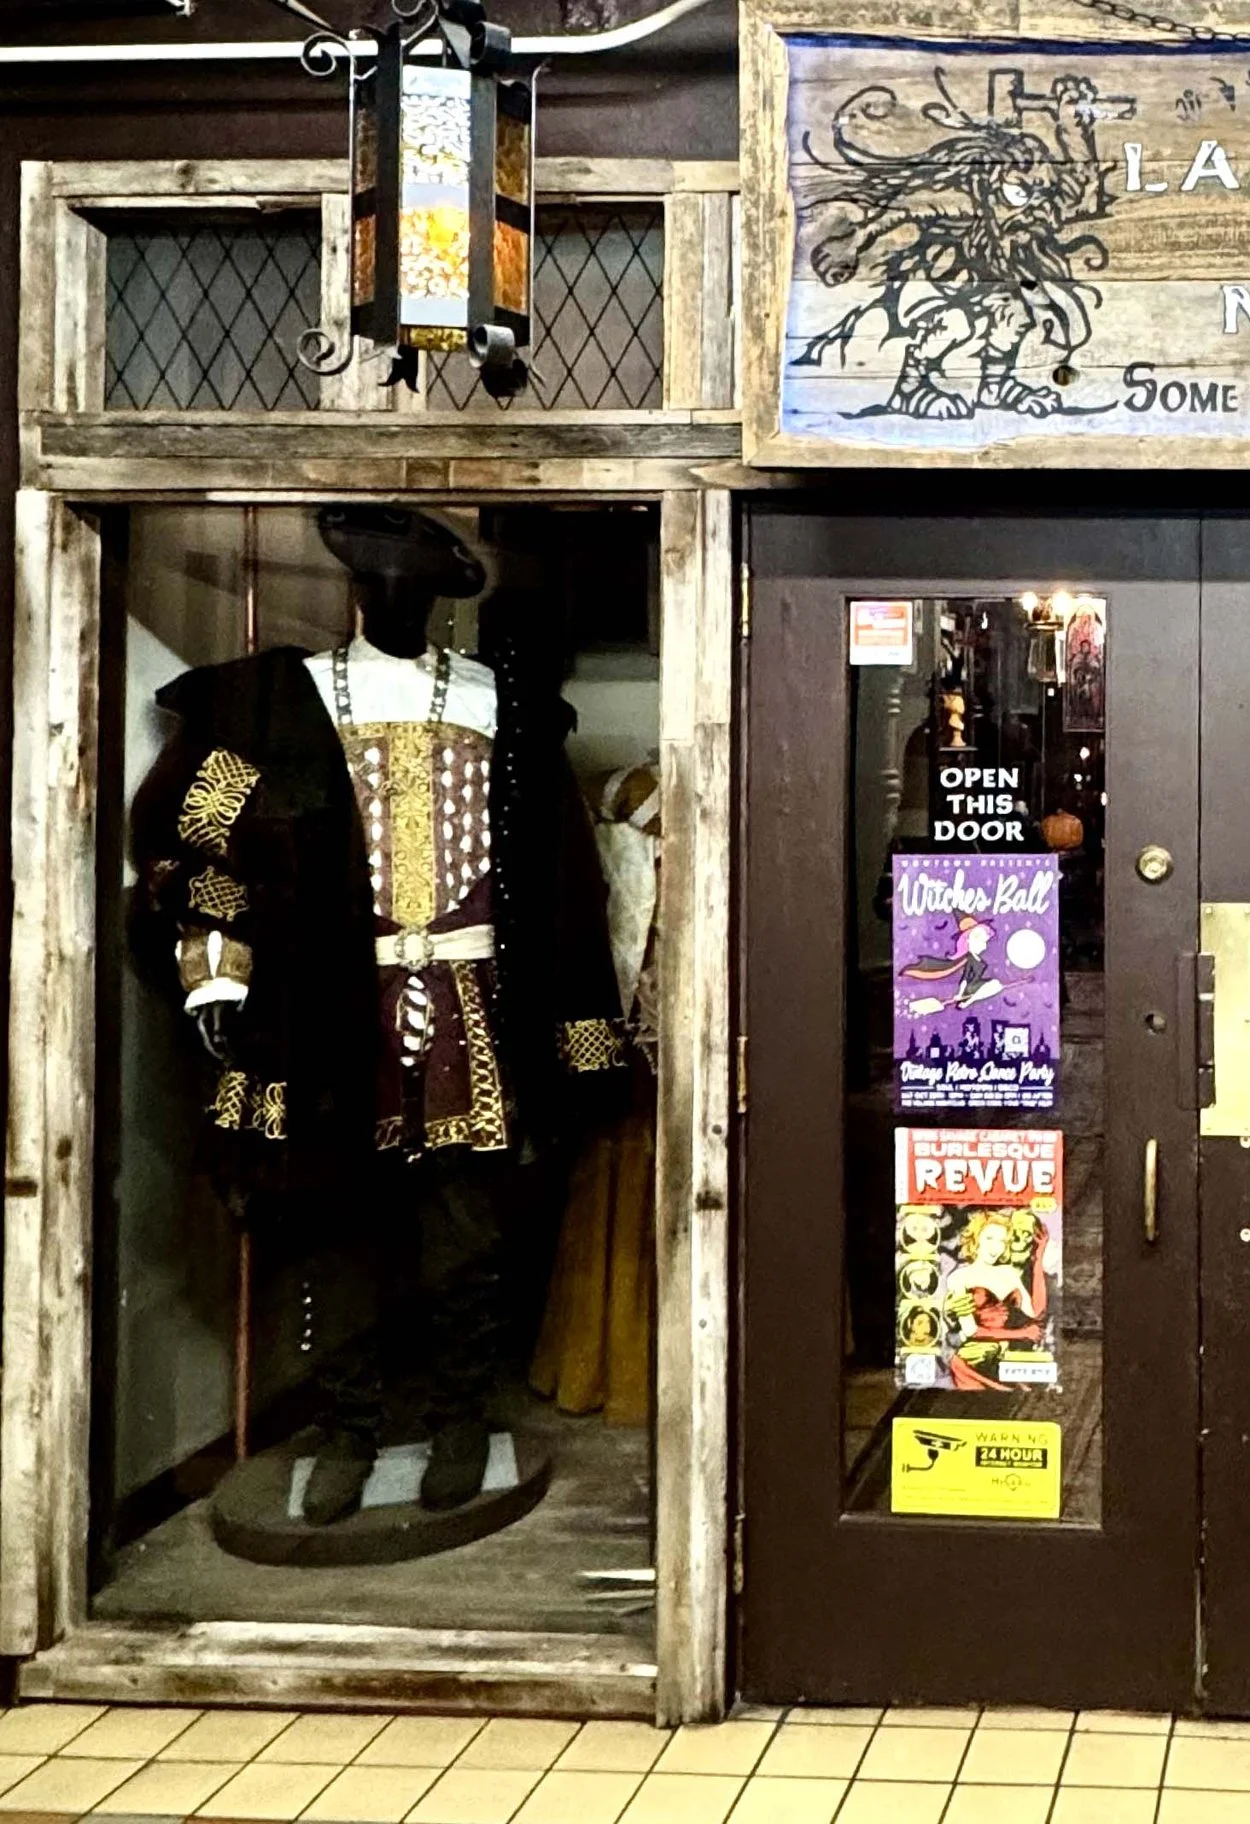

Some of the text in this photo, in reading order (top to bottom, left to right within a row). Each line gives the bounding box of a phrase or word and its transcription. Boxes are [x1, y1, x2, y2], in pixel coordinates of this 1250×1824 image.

[940, 767, 1019, 788] OPEN
[946, 794, 1013, 815] THIS
[934, 820, 1024, 841] DOOR
[898, 869, 1054, 916] Witches Ball
[914, 1142, 1055, 1160] BURLESQUE
[914, 1159, 1055, 1196] REVUE
[981, 1448, 1043, 1461] 24 HOUR
